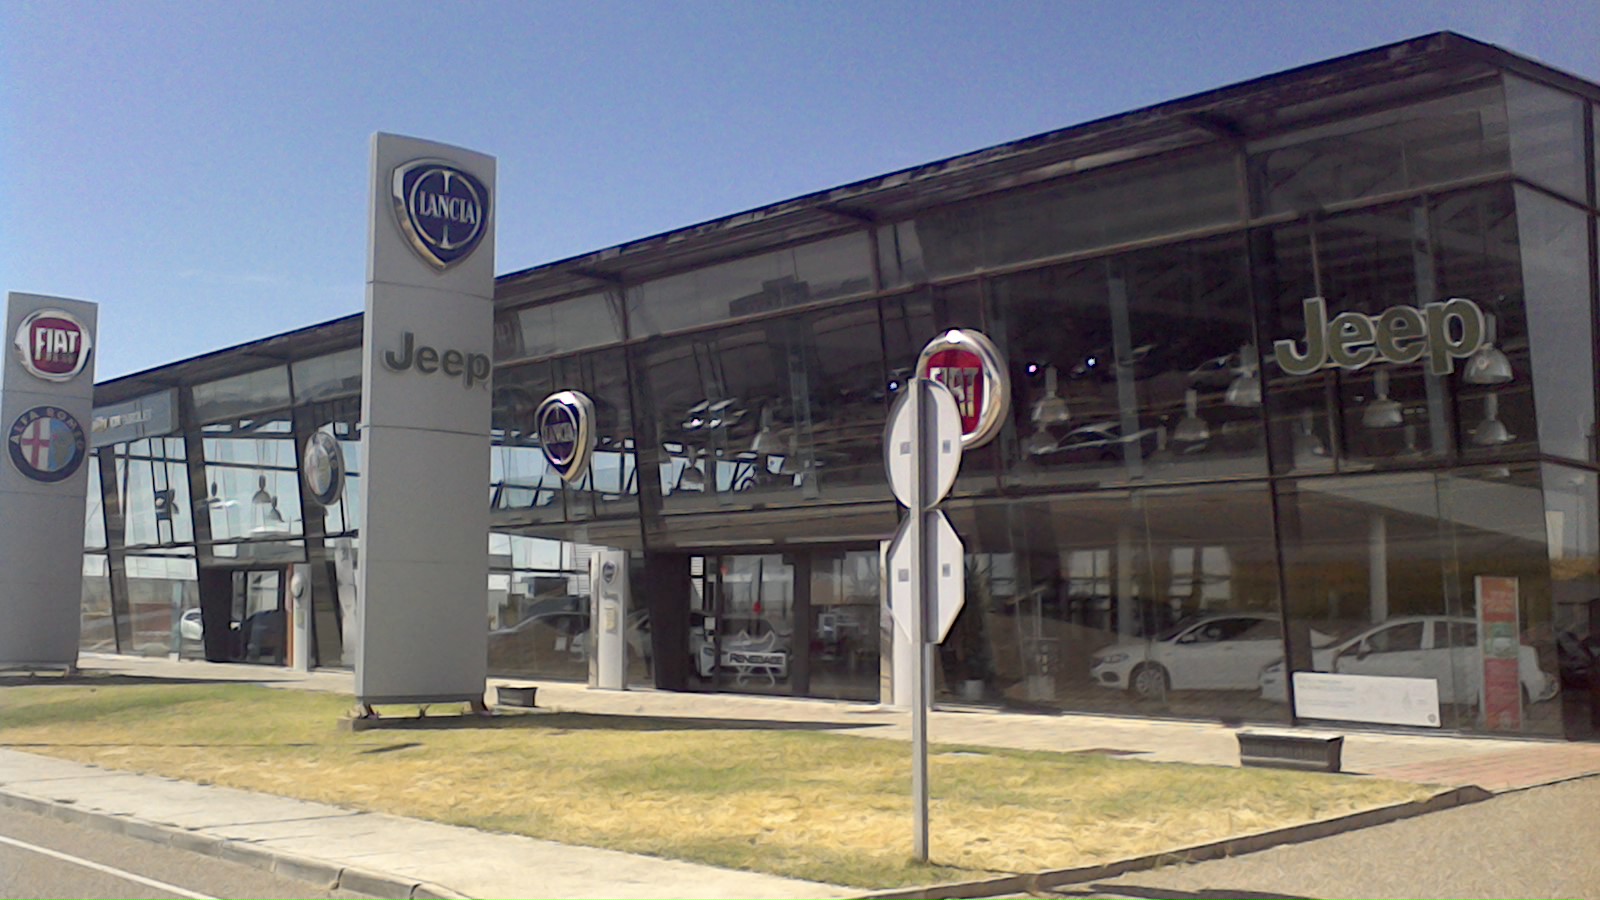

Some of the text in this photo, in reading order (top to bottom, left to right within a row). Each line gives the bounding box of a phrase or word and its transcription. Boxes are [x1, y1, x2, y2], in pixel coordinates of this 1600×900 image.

[419, 190, 477, 225] LANCIA
[34, 327, 80, 364] FIAT
[1273, 297, 1485, 376] Jeep
[384, 331, 491, 389] Jeep
[10, 411, 40, 445] ALFA
